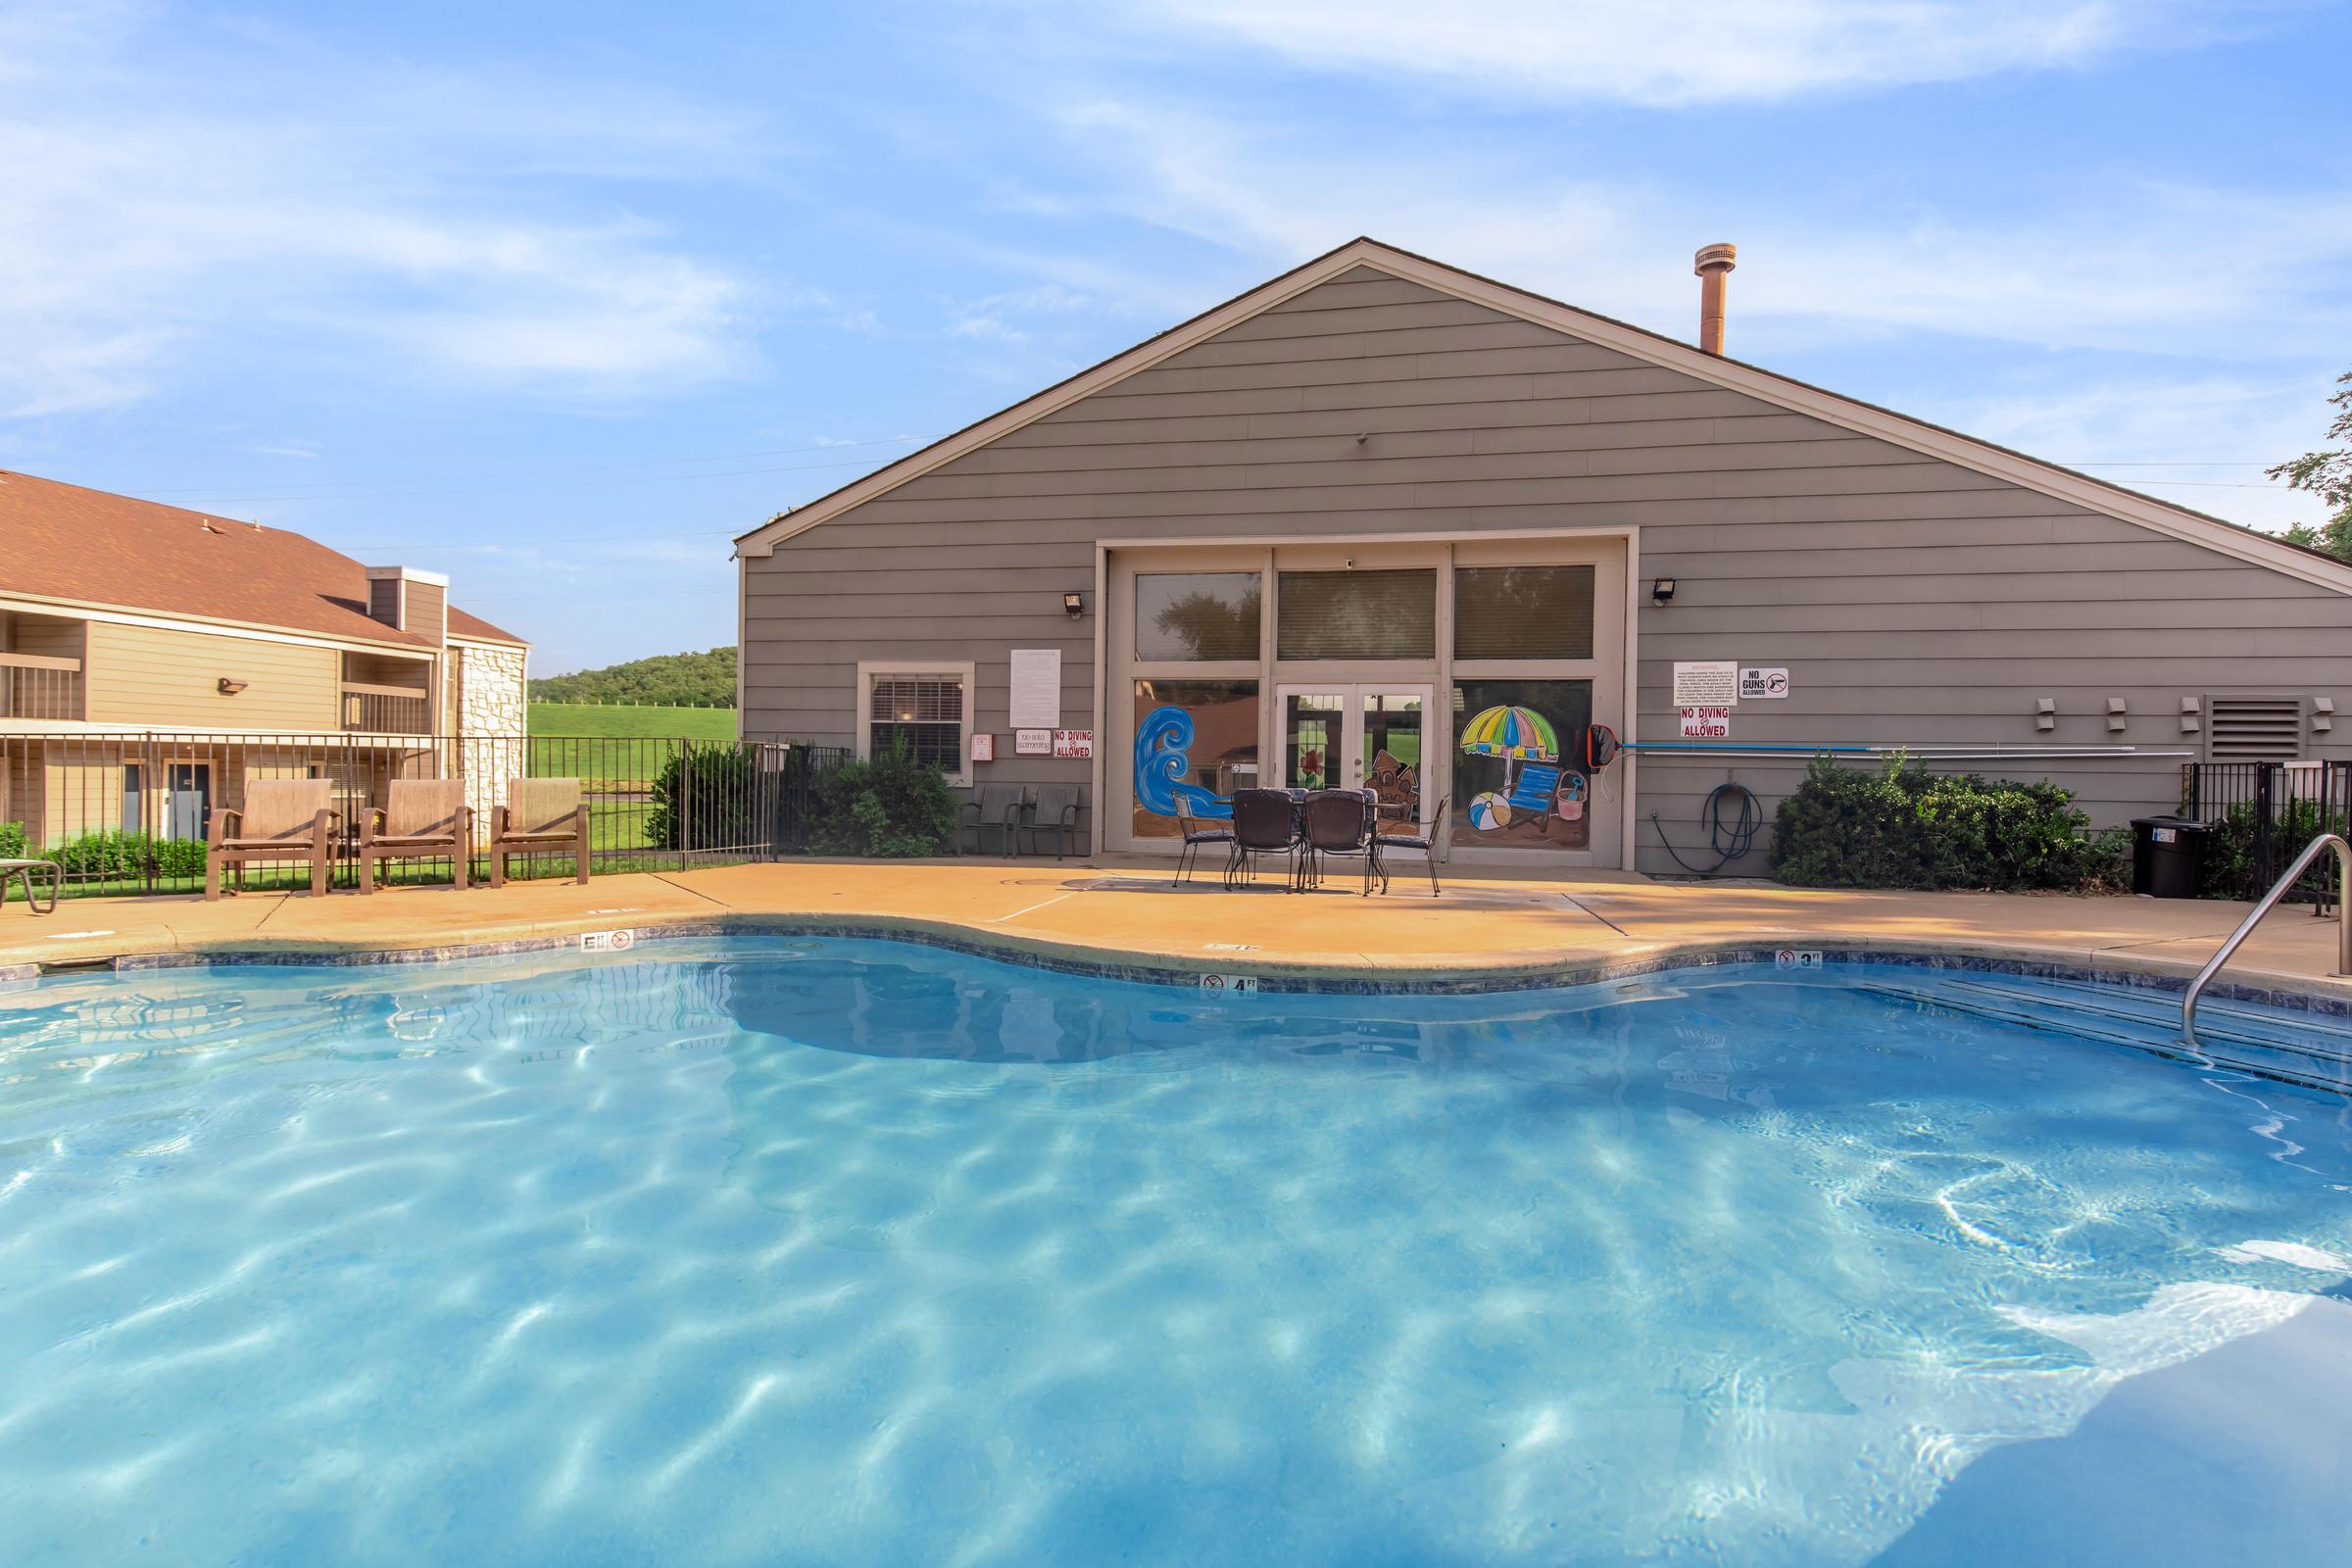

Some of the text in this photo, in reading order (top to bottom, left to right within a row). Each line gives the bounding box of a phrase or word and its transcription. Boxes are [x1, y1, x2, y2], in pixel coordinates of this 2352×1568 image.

[1748, 670, 1759, 679] NO
[1742, 680, 1765, 689] GUNS
[1681, 708, 1728, 718] NO DIVING
[1054, 730, 1092, 740] NO DIVING
[1685, 726, 1725, 736] ALLOWED
[1057, 747, 1089, 756] ALLOWED
[1233, 979, 1245, 991] 4
